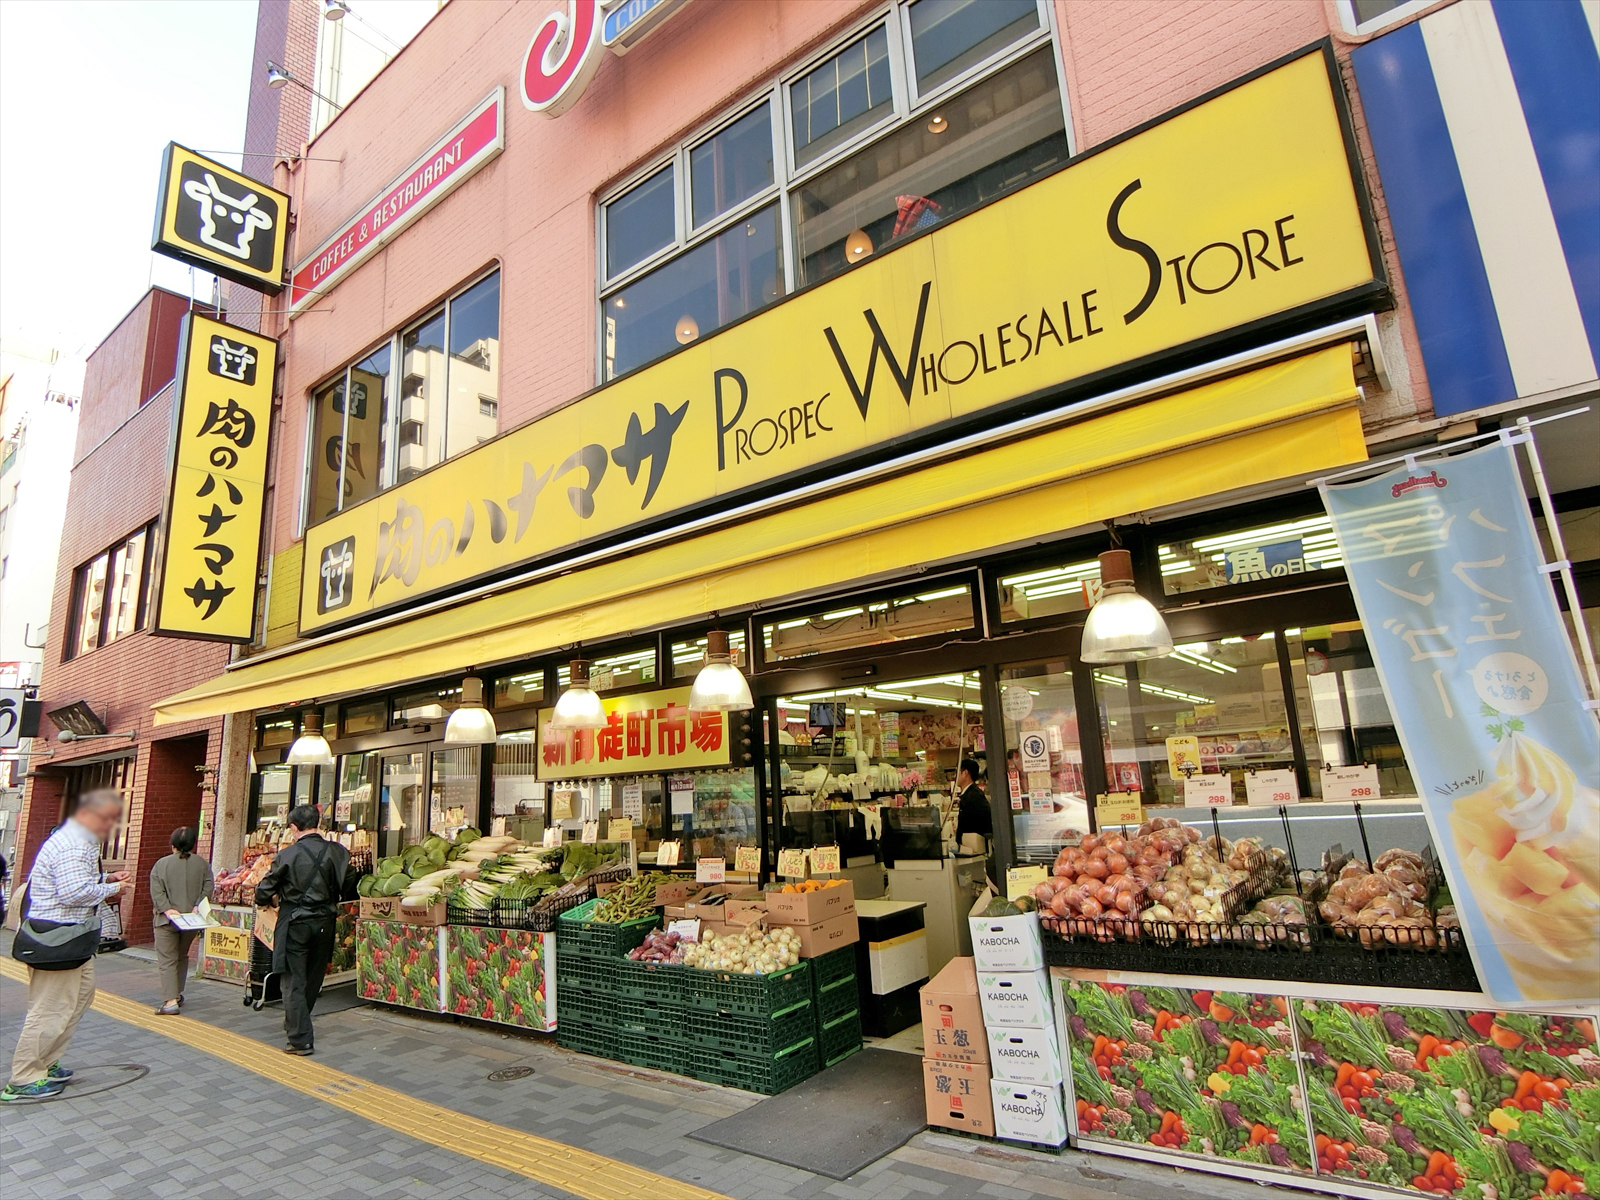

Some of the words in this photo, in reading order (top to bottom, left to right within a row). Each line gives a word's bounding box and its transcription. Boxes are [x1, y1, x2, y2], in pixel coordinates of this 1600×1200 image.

[311, 232, 355, 282] COFFEE
[357, 223, 369, 243] &
[372, 137, 466, 232] RESTAURANT
[713, 368, 834, 472] PROSPEC
[823, 280, 1104, 422] WHOLESALE
[1106, 178, 1305, 325] STORE
[368, 399, 690, 601] 肉のハナマサ
[183, 398, 257, 621] 肉のハナマサ
[1227, 547, 1304, 585] 魚の日
[542, 702, 723, 767] 新御徒町市場
[1272, 792, 1291, 801] 298
[1351, 787, 1371, 797] 298
[1208, 795, 1226, 803] 298
[1120, 813, 1136, 821] 298
[740, 861, 756, 870] 150
[783, 864, 800, 874] 150
[817, 861, 835, 870] 98
[210, 931, 241, 950] 青果ケース
[979, 936, 1021, 946] KABOCHA
[987, 992, 1029, 1002] KABOCHA
[931, 1028, 970, 1047] 玉葱
[997, 1048, 1040, 1058] KABOCHA
[934, 1075, 976, 1096] 玉葱
[1001, 1102, 1045, 1116] KABOCHA
